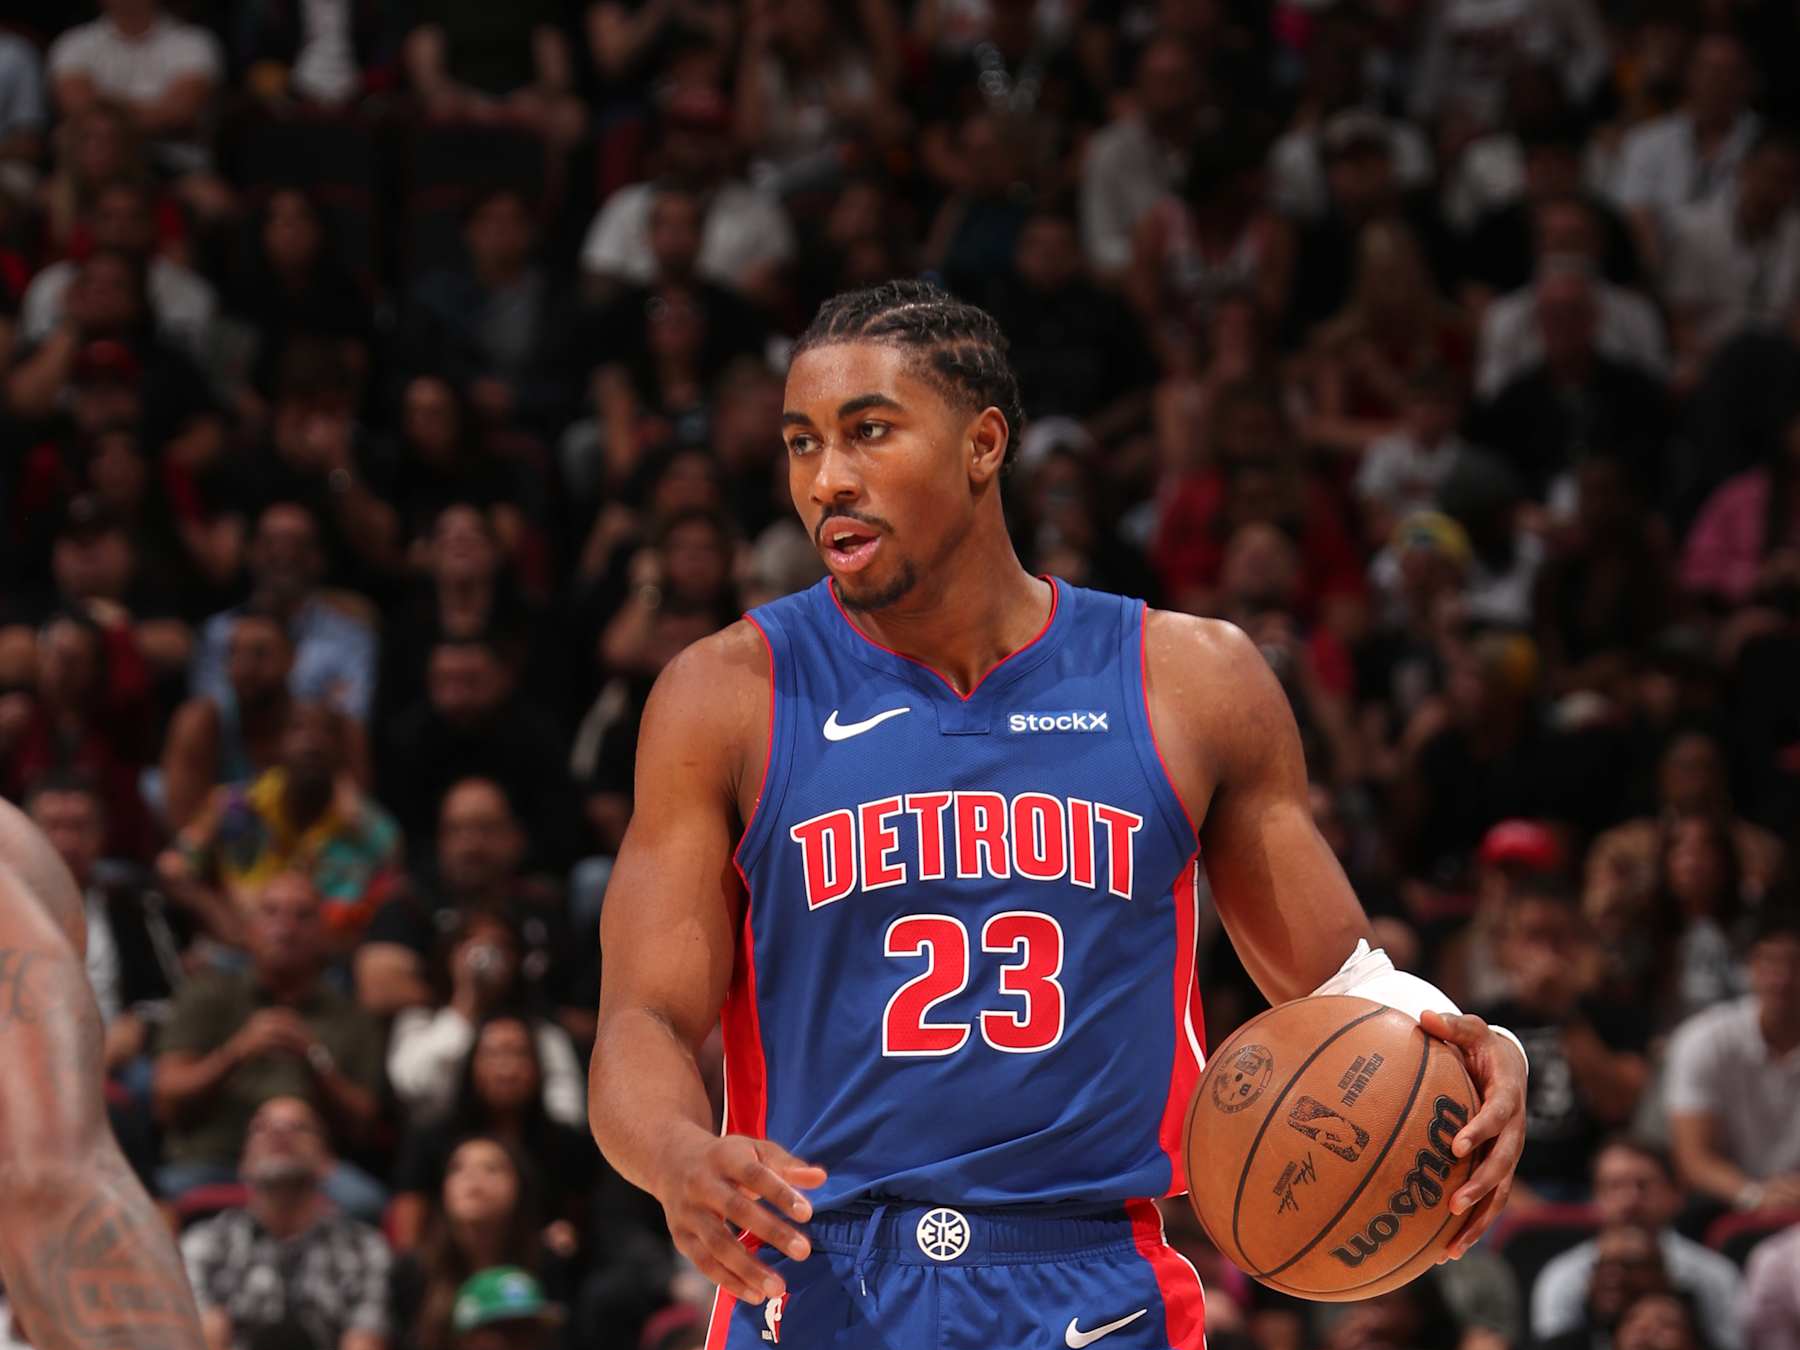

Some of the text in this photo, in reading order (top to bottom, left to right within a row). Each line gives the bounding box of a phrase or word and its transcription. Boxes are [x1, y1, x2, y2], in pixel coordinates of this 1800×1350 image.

[1009, 711, 1108, 731] StockX
[790, 790, 1143, 911] DETROIT
[882, 910, 1065, 1057] 23
